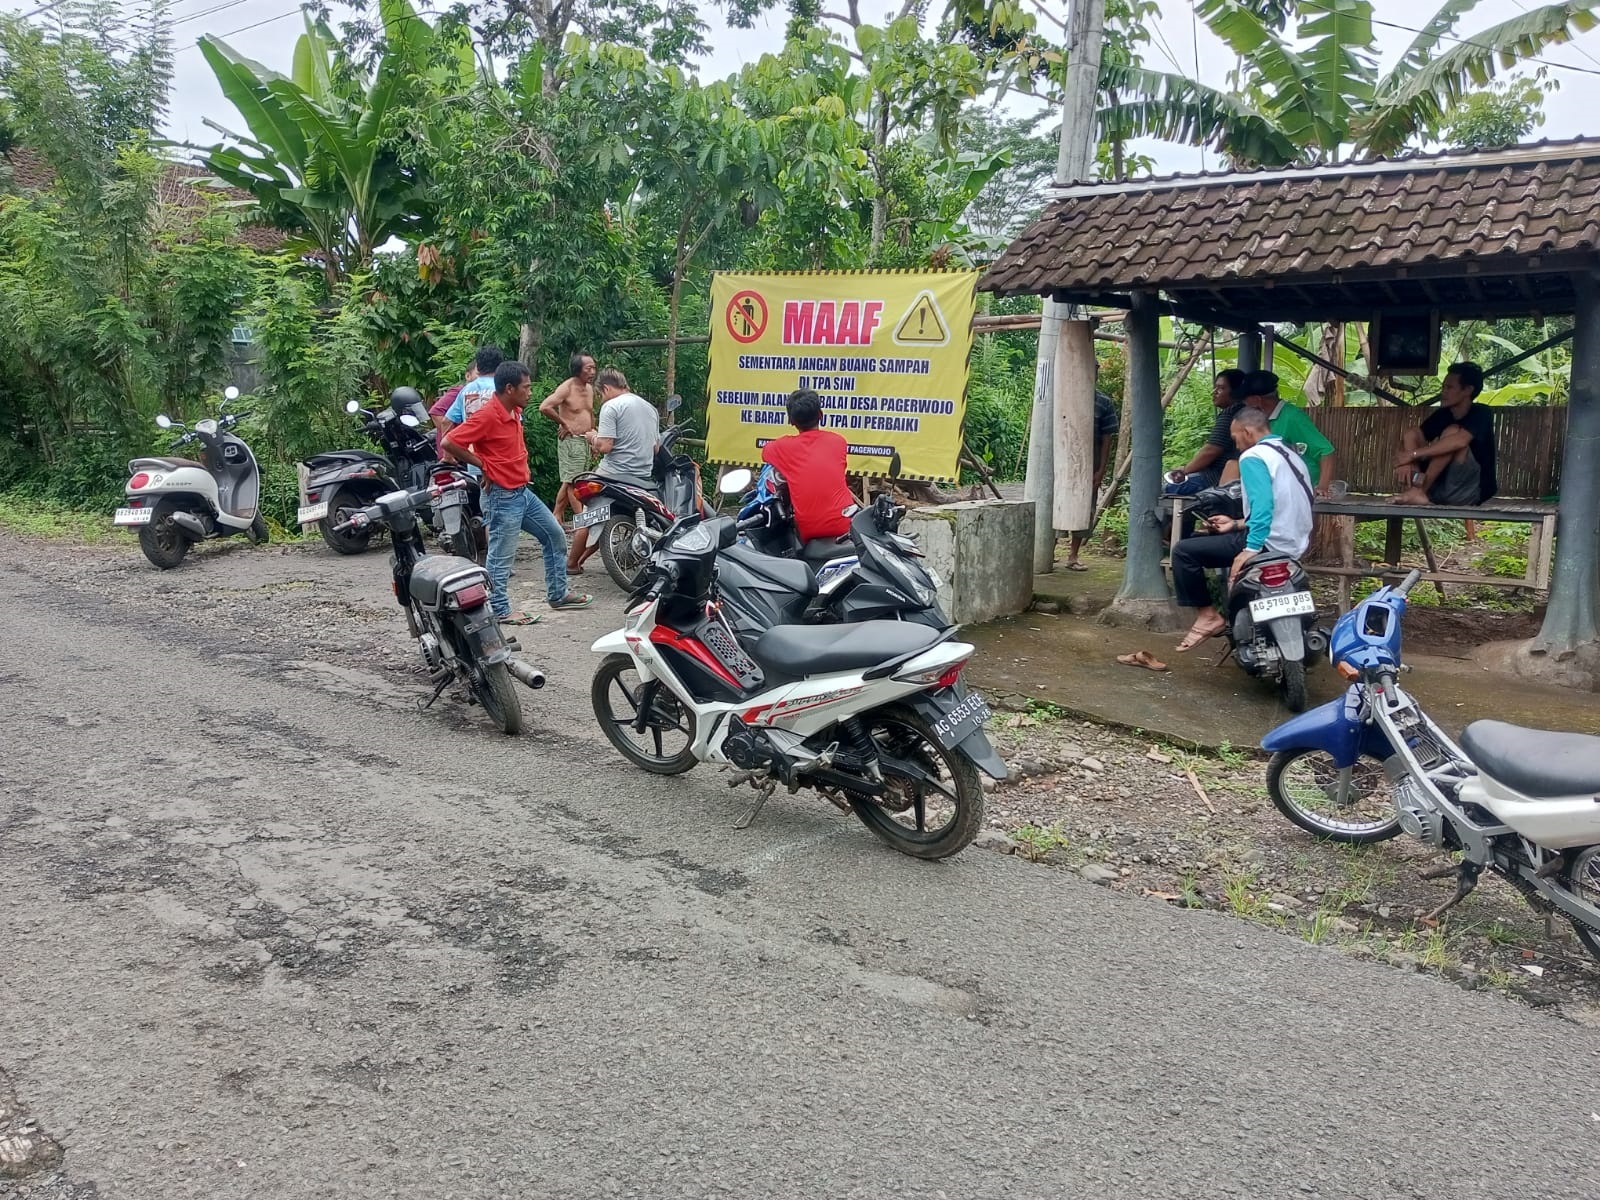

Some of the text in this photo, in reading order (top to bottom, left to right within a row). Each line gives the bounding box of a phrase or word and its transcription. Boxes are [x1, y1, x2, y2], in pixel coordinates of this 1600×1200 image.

[782, 301, 884, 345] MAAF
[738, 355, 930, 374] SEMENTARA JANGAN BUANG SAMPAH
[799, 375, 855, 391] DI TPA SINI
[717, 390, 759, 405] SEBELUM
[819, 395, 849, 410] BALAI
[850, 396, 878, 411] DESA
[880, 397, 954, 415] PAGERWOJO
[741, 409, 753, 423] KE
[754, 410, 786, 425] BARAT
[829, 414, 849, 428] TPA
[850, 415, 862, 429] DI
[864, 416, 919, 432] PERBAIKI
[850, 445, 892, 456] PAGERWOJO
[1253, 601, 1265, 612] AG
[934, 693, 985, 737] AG 6553 ECE
